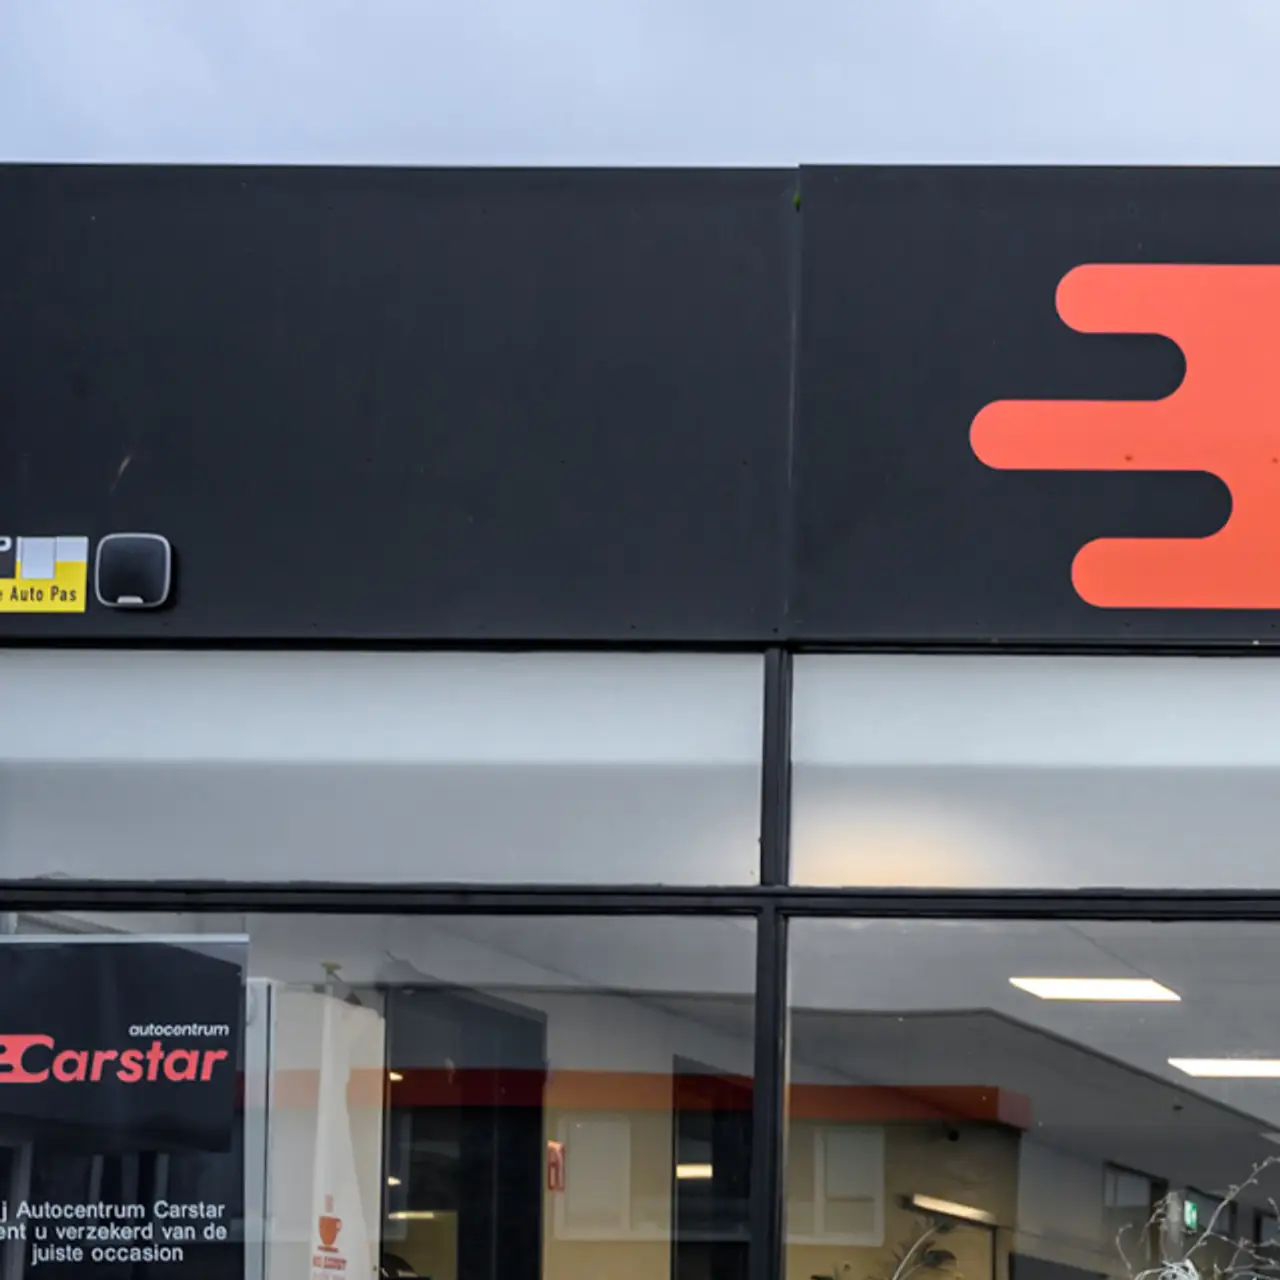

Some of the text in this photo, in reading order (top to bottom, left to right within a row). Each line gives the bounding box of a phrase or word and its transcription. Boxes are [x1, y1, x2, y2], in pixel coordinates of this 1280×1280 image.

[10, 586, 44, 602] Auto
[50, 585, 77, 602] Pas
[128, 1023, 230, 1037] autocentrum
[0, 1034, 228, 1083] Carstar
[16, 1200, 145, 1219] Autocentrum
[154, 1200, 226, 1219] Carstar
[35, 1226, 47, 1240] u
[56, 1222, 153, 1240] verzekerd
[162, 1226, 196, 1240] van
[203, 1222, 227, 1240] de
[31, 1243, 184, 1266] juiste occasion
